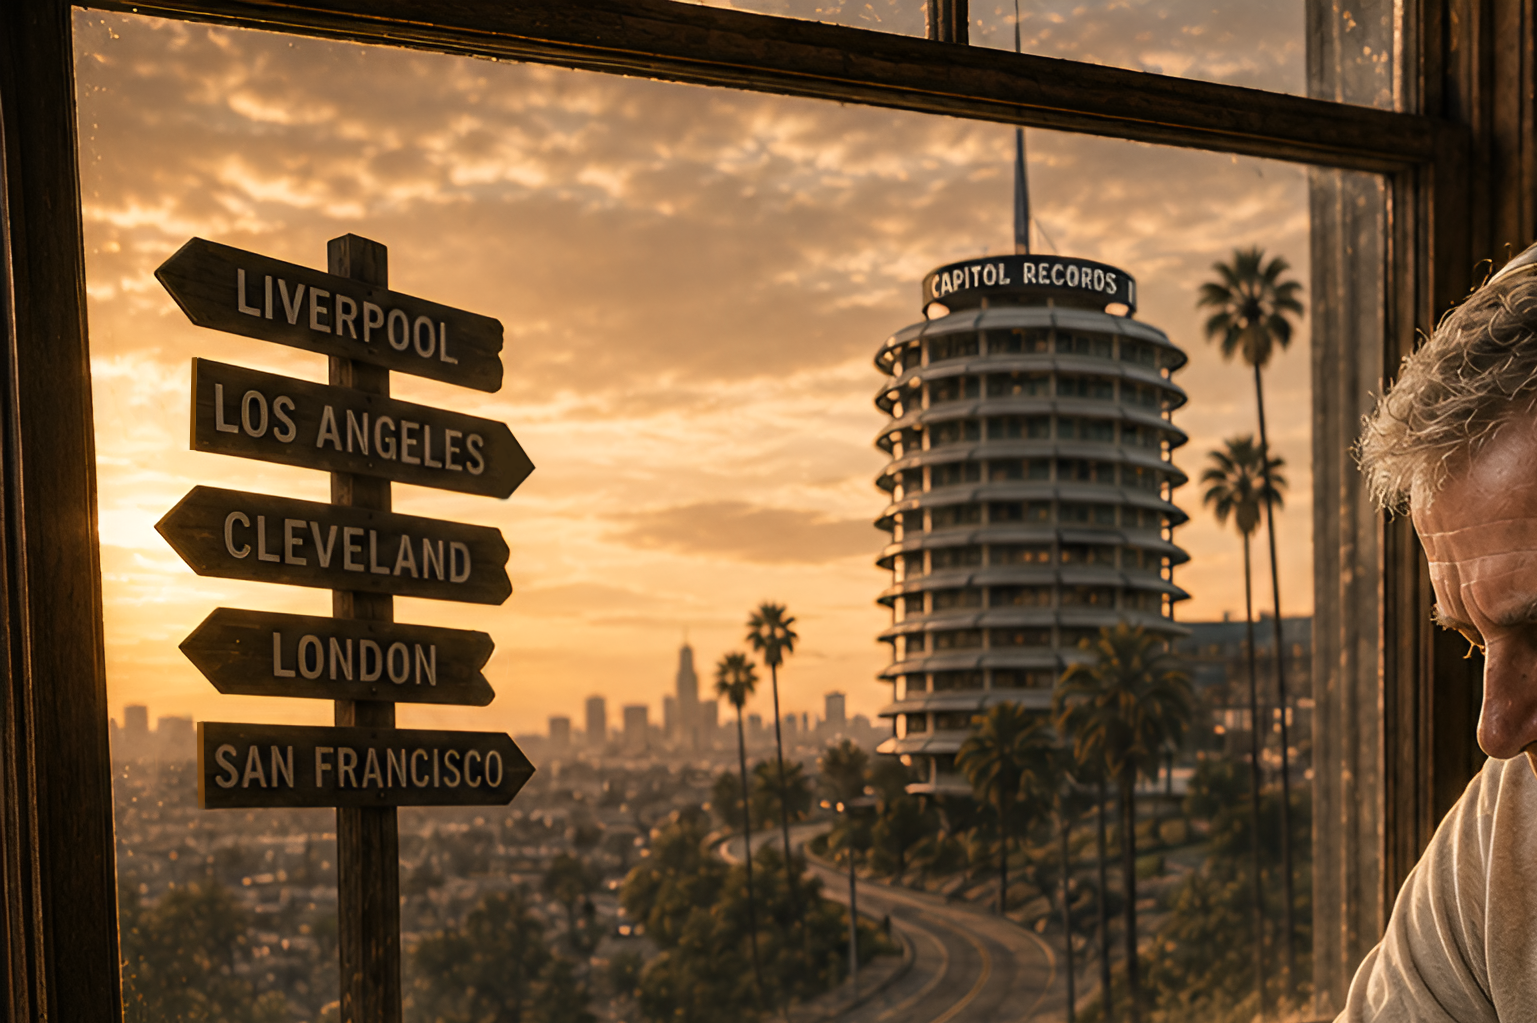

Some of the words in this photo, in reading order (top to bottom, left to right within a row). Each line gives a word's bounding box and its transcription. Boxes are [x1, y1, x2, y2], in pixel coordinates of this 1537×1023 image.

[931, 263, 1011, 299] CAPITOL
[1023, 262, 1118, 294] RECORDS
[237, 267, 459, 366] LIVERPOOL
[214, 383, 297, 443] LOS
[316, 405, 485, 475] ANGELES
[223, 510, 472, 584] CLEVELAND
[272, 631, 438, 687] LONDON
[214, 743, 295, 790] SAN
[314, 746, 503, 789] FRANCISCO
